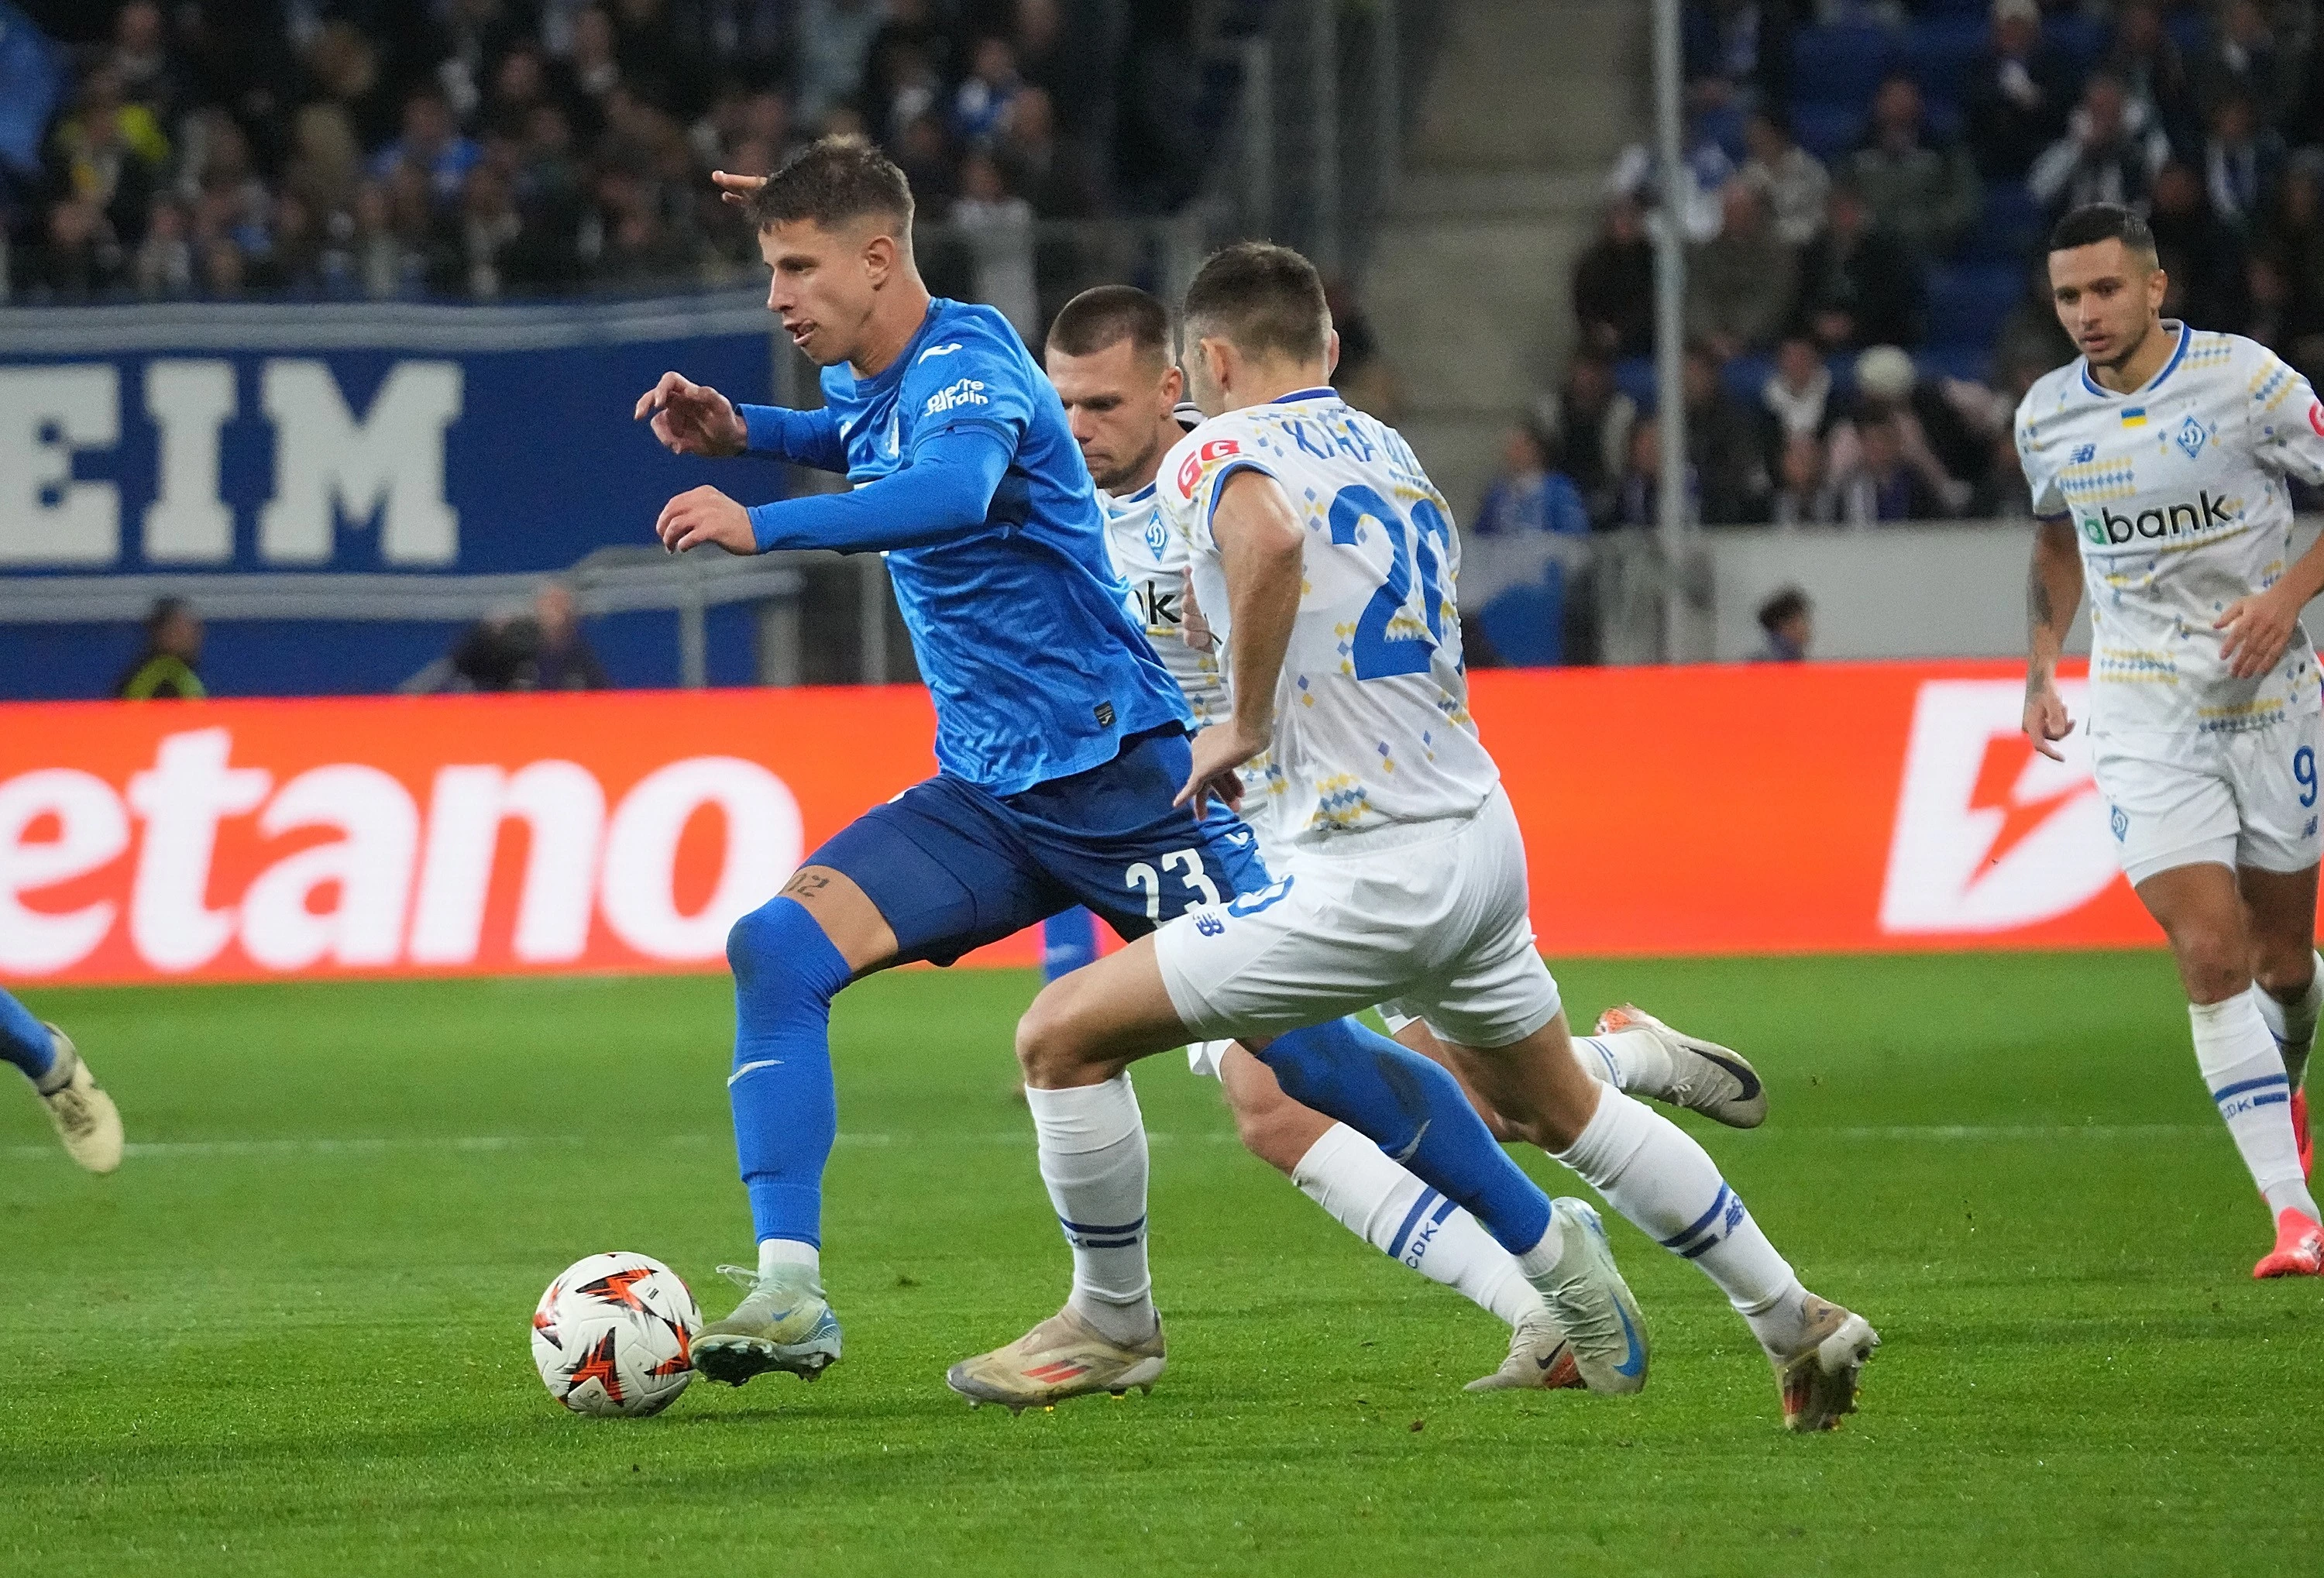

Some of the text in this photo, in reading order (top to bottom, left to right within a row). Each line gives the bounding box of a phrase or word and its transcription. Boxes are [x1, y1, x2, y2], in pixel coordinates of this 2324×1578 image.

[0, 358, 462, 565] EIM
[1177, 439, 1241, 499] GG
[2293, 745, 2318, 807] 9
[0, 727, 804, 973] etano
[1126, 848, 1220, 930] 23
[1406, 1222, 1438, 1269] CDK
